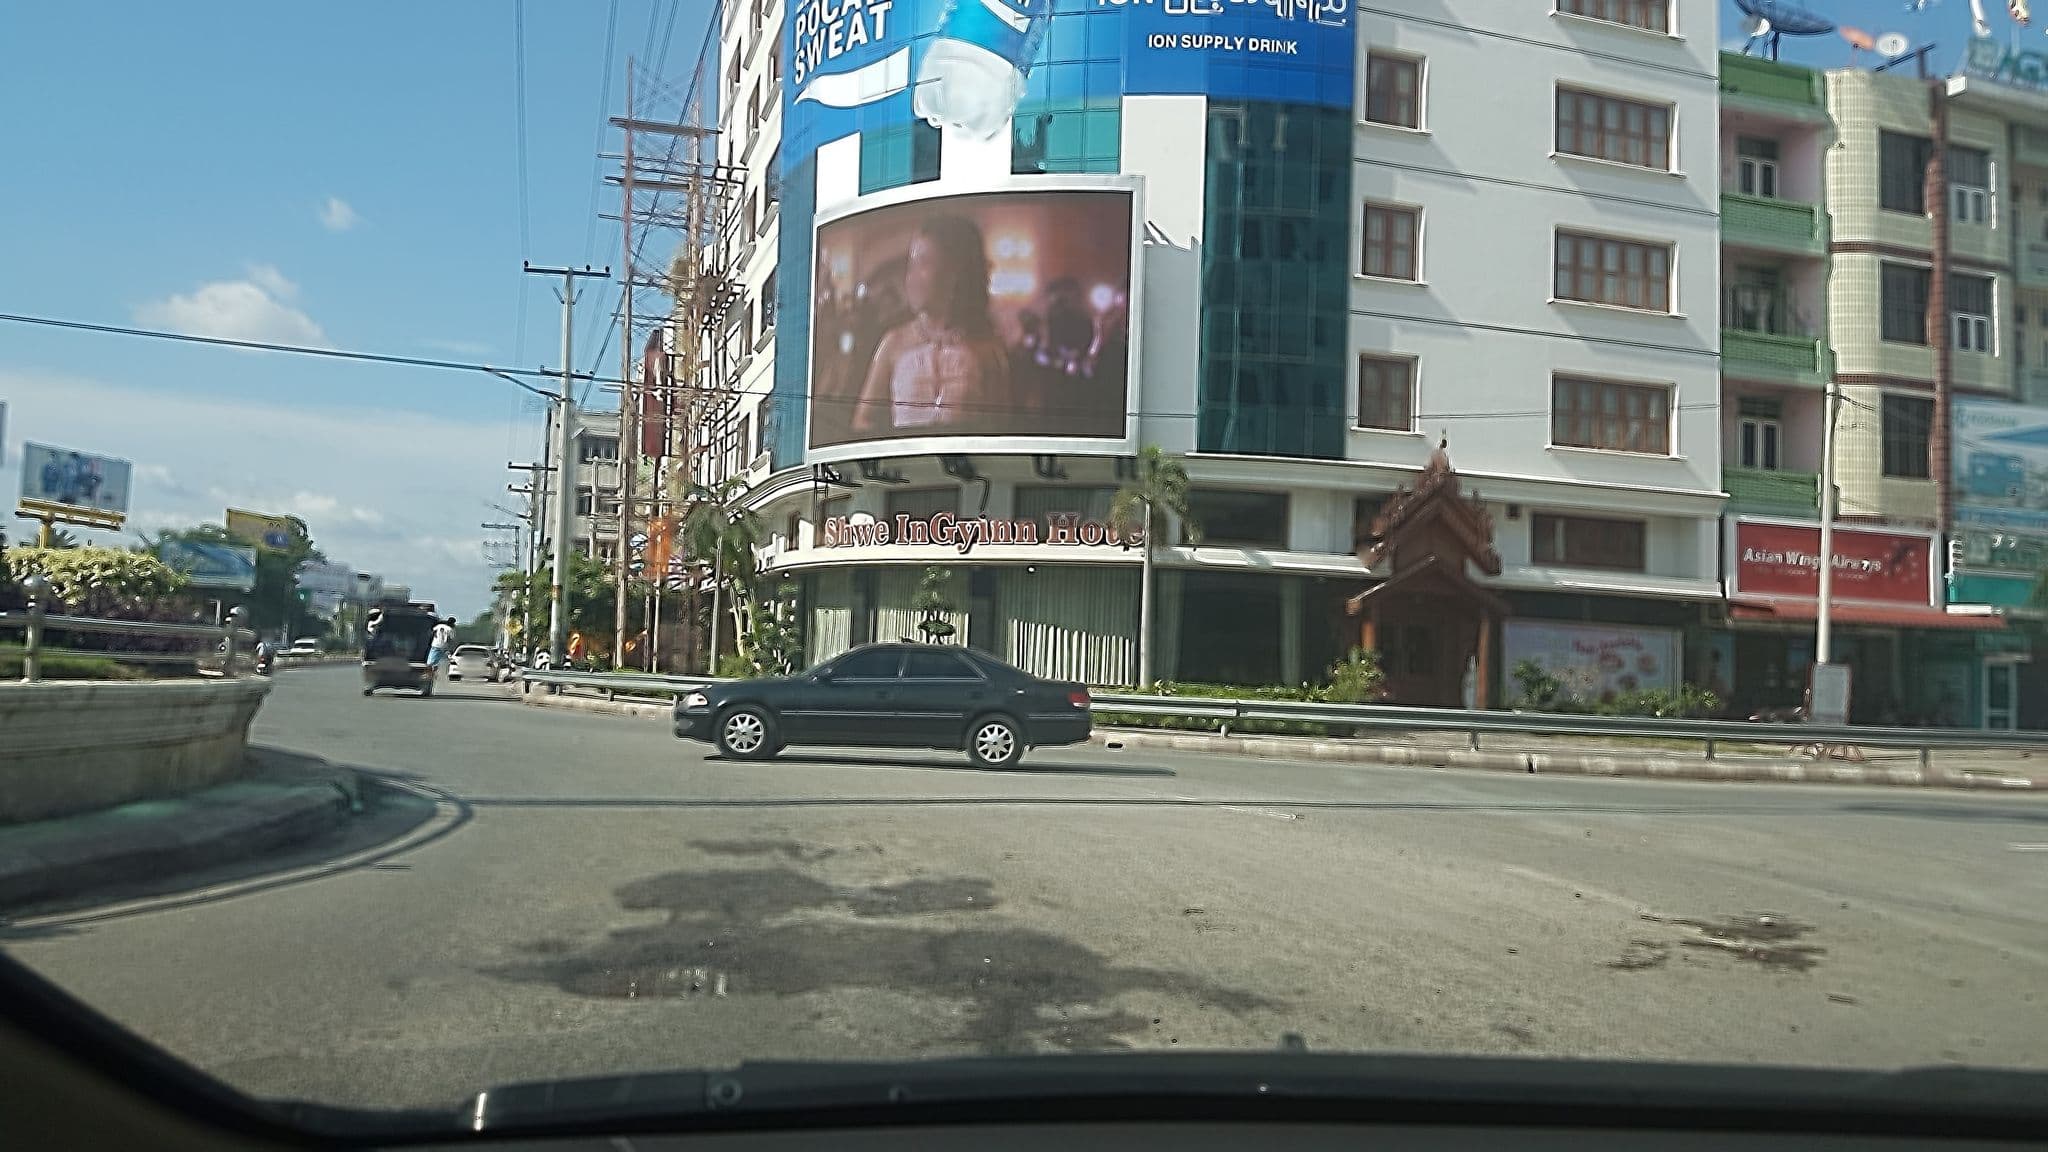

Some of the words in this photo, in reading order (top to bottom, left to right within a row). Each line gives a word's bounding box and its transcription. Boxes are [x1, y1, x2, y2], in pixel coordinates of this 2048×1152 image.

[795, 2, 892, 85] SWEAT
[1148, 34, 1177, 48] ION
[1181, 34, 1245, 50] SUPPLY
[1249, 38, 1298, 55] DRINK
[825, 515, 890, 548] Shwe
[895, 511, 1038, 553] InGyinn
[1046, 511, 1146, 547] Hote
[1743, 547, 1783, 563] Asian
[1785, 551, 1821, 571] Wing
